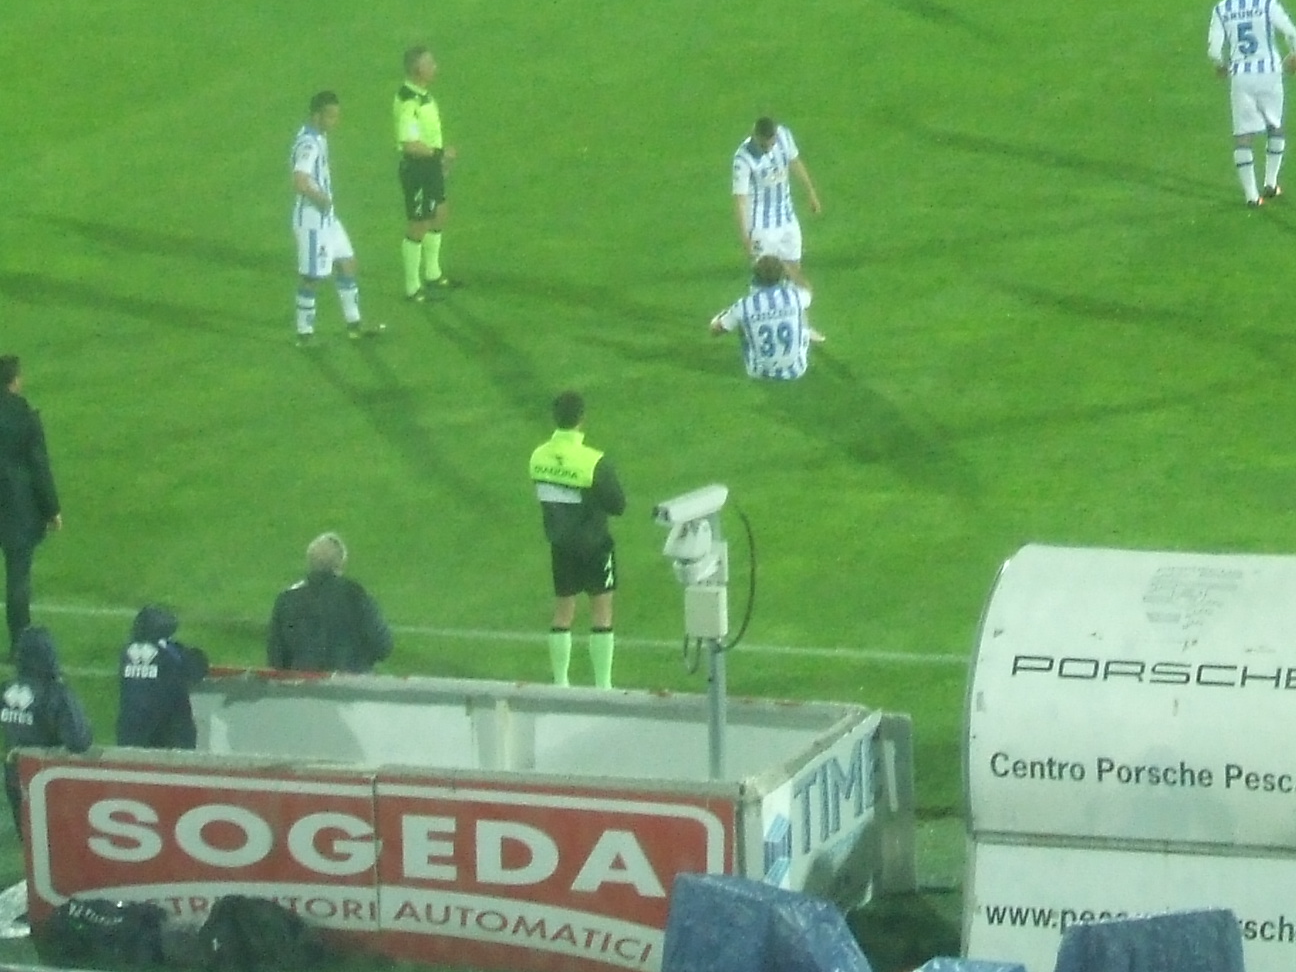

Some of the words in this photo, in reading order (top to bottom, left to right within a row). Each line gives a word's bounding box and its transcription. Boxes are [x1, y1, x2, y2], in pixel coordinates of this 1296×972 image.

[1237, 22, 1259, 55] 5
[758, 321, 794, 358] 39
[990, 751, 1085, 782] Centro
[1096, 757, 1213, 789] Porsche
[86, 798, 666, 898] SOGEDA
[394, 901, 653, 964] AUTOMATICI
